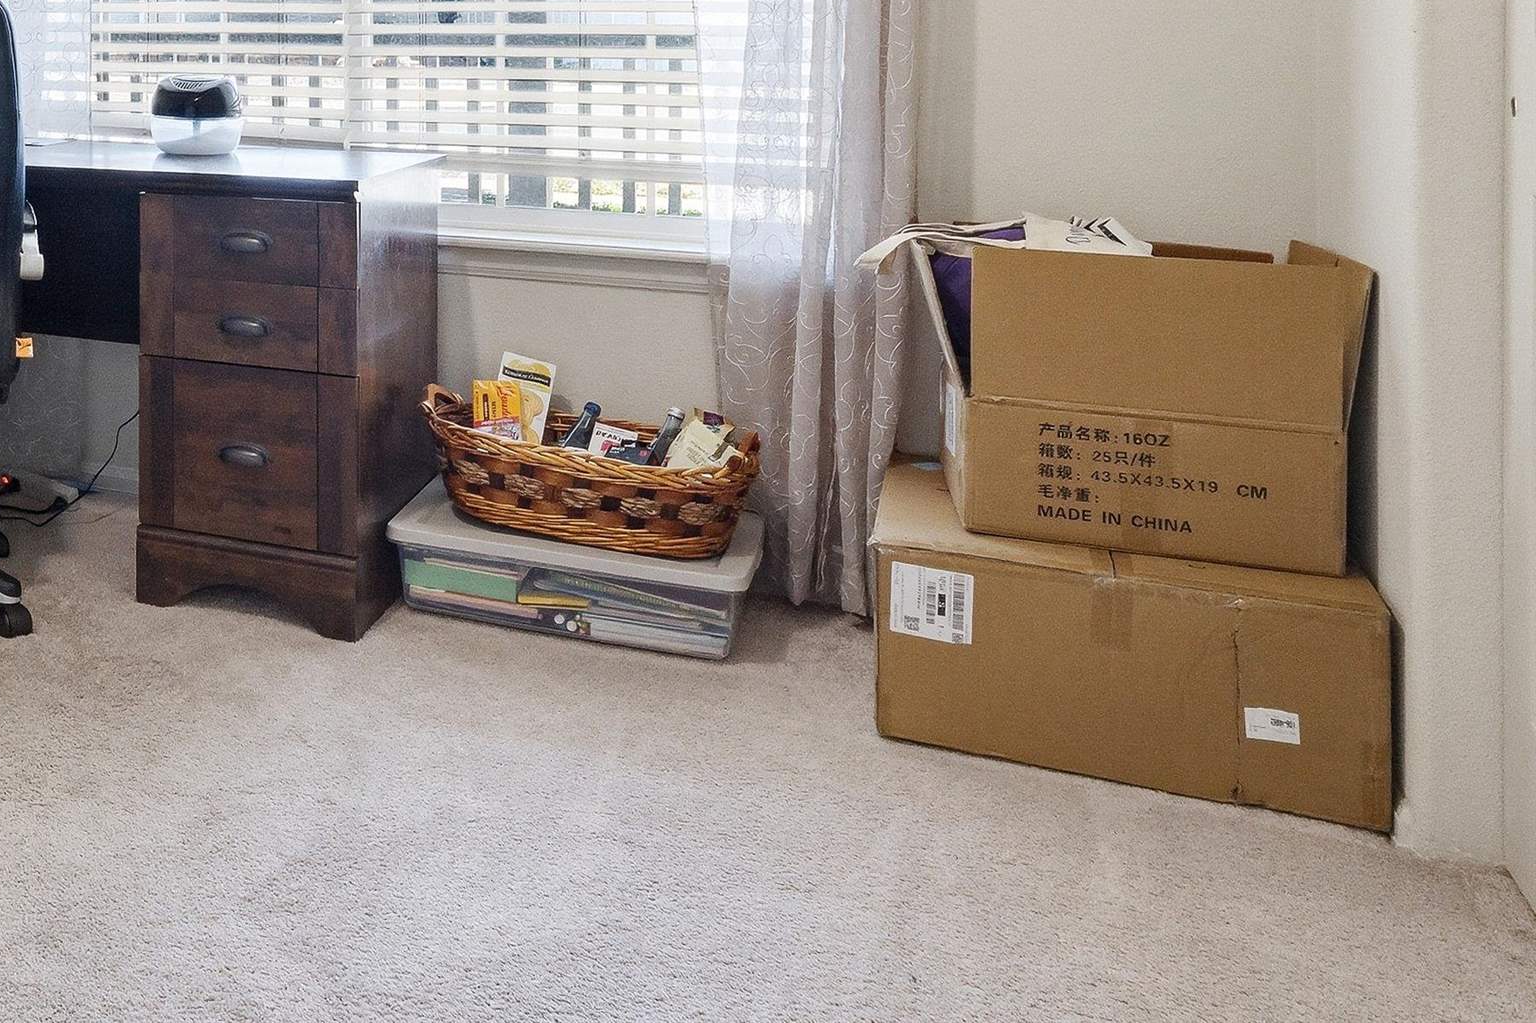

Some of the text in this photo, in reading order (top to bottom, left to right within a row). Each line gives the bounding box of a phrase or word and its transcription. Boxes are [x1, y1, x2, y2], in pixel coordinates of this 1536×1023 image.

[1236, 485, 1268, 500] CM
[1037, 505, 1192, 533] MADE IN CHINA
